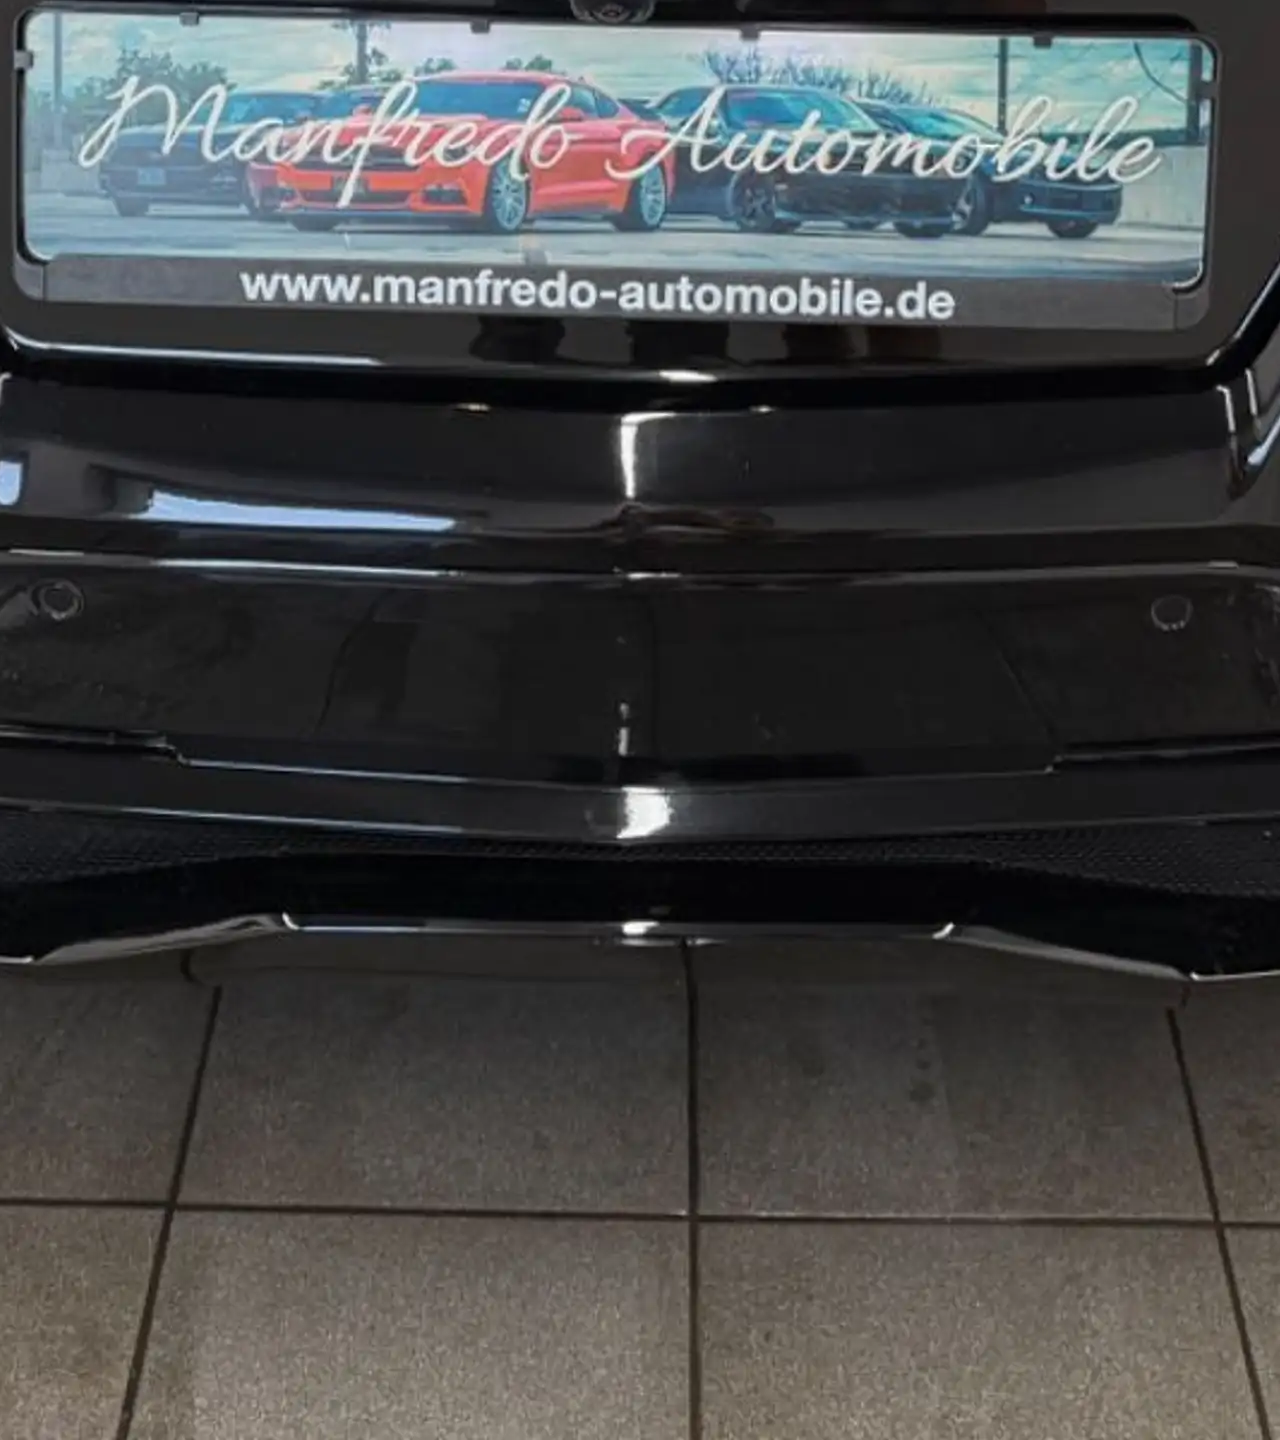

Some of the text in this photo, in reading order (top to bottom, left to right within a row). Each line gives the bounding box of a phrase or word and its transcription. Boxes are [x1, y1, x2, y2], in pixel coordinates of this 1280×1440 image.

[78, 75, 1165, 208] Manfredo Automobile
[240, 269, 956, 321] www.manfredo-automobile.de
